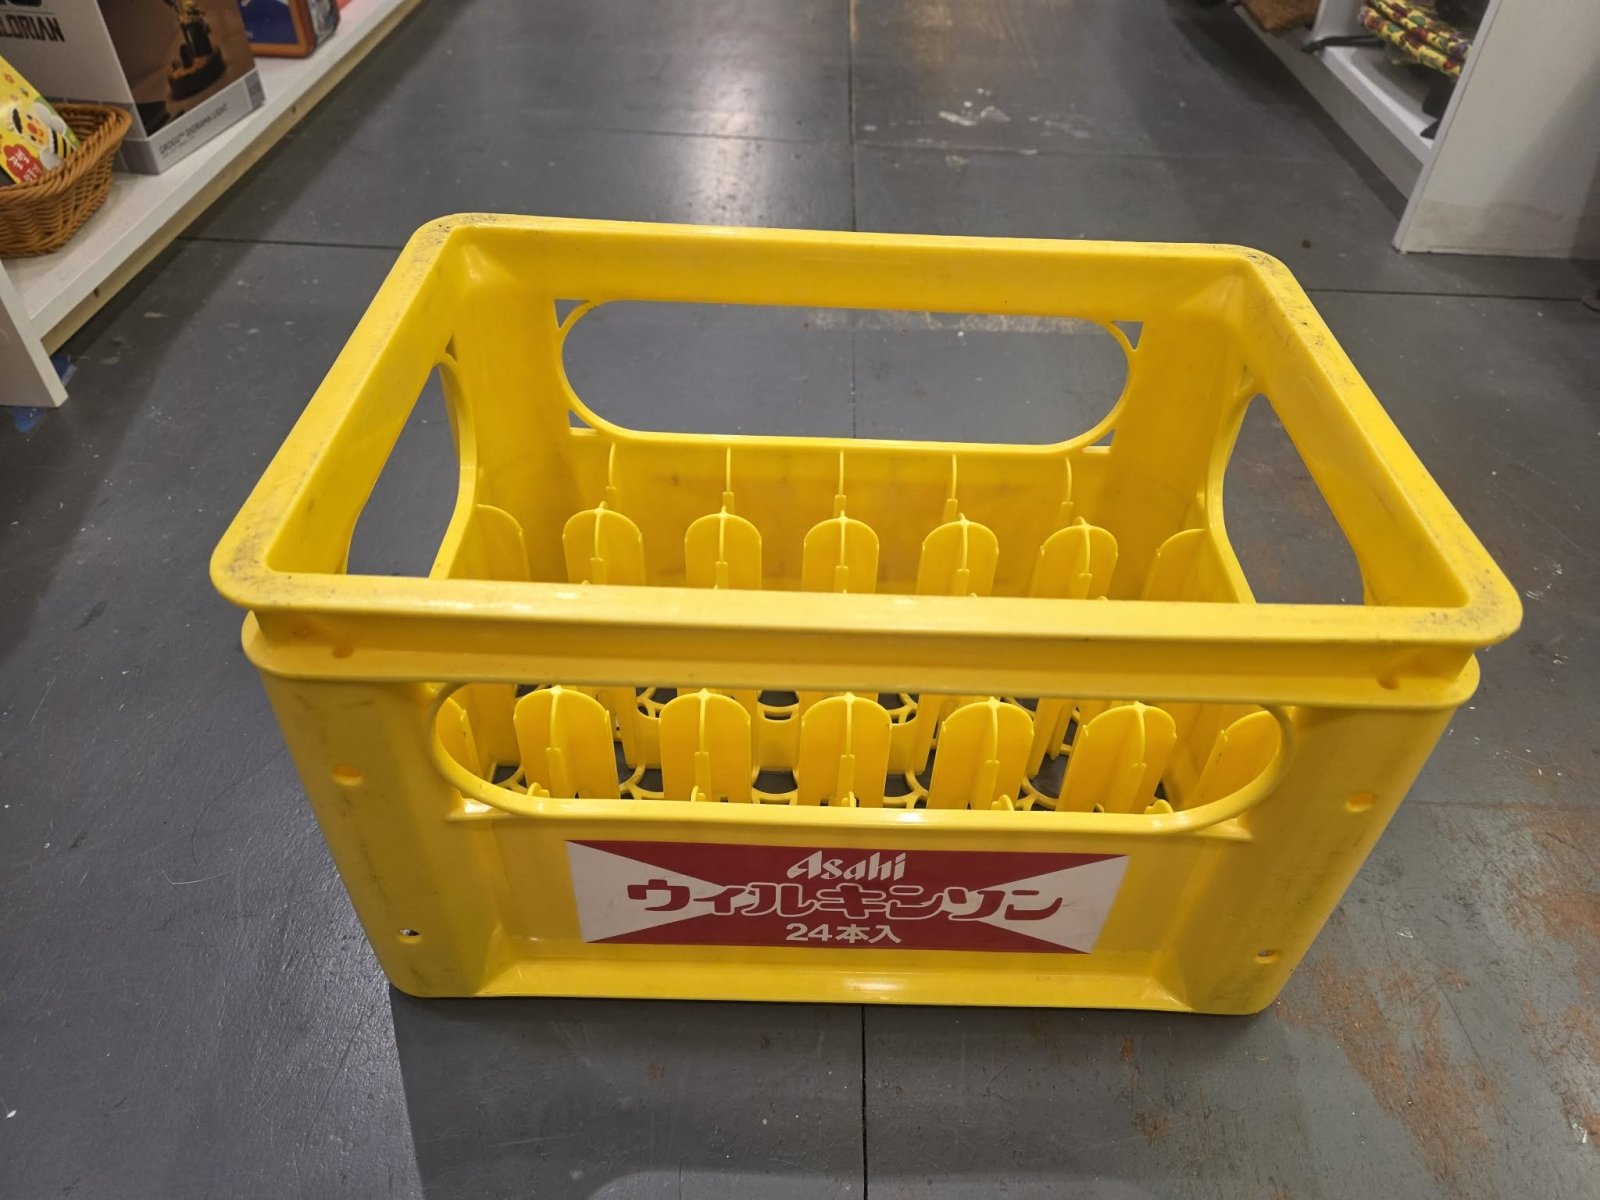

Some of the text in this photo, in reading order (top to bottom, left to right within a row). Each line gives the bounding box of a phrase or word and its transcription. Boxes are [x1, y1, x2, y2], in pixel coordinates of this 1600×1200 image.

[0, 14, 65, 42] LORIAN
[787, 850, 906, 881] Asahi
[626, 878, 1063, 922] ウィルキンソン
[785, 922, 902, 944] 24本入
